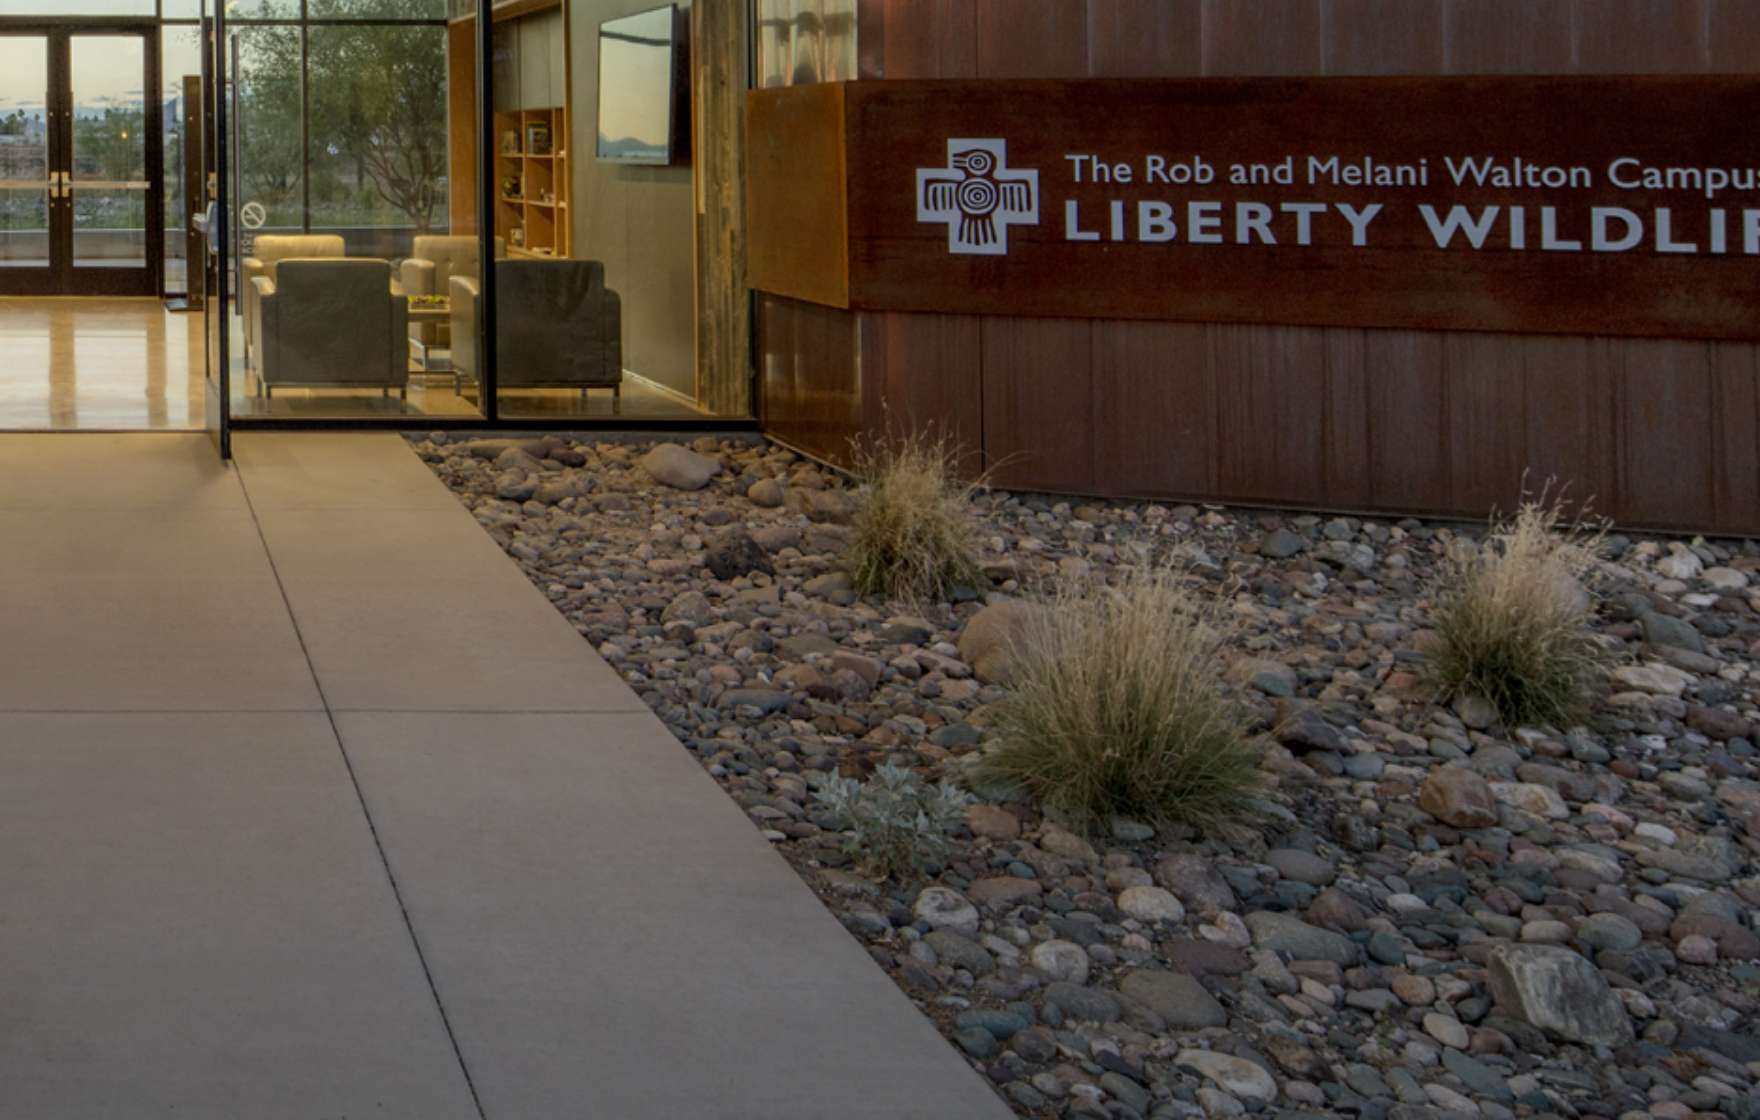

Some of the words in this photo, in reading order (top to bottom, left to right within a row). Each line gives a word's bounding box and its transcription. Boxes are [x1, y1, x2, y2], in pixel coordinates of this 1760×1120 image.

[1064, 154, 1132, 183] The
[1146, 154, 1214, 184] Rob
[1229, 155, 1293, 184] and
[1308, 155, 1428, 186] Melani
[1444, 156, 1591, 188] Walton
[1065, 199, 1383, 246] LIBERTY
